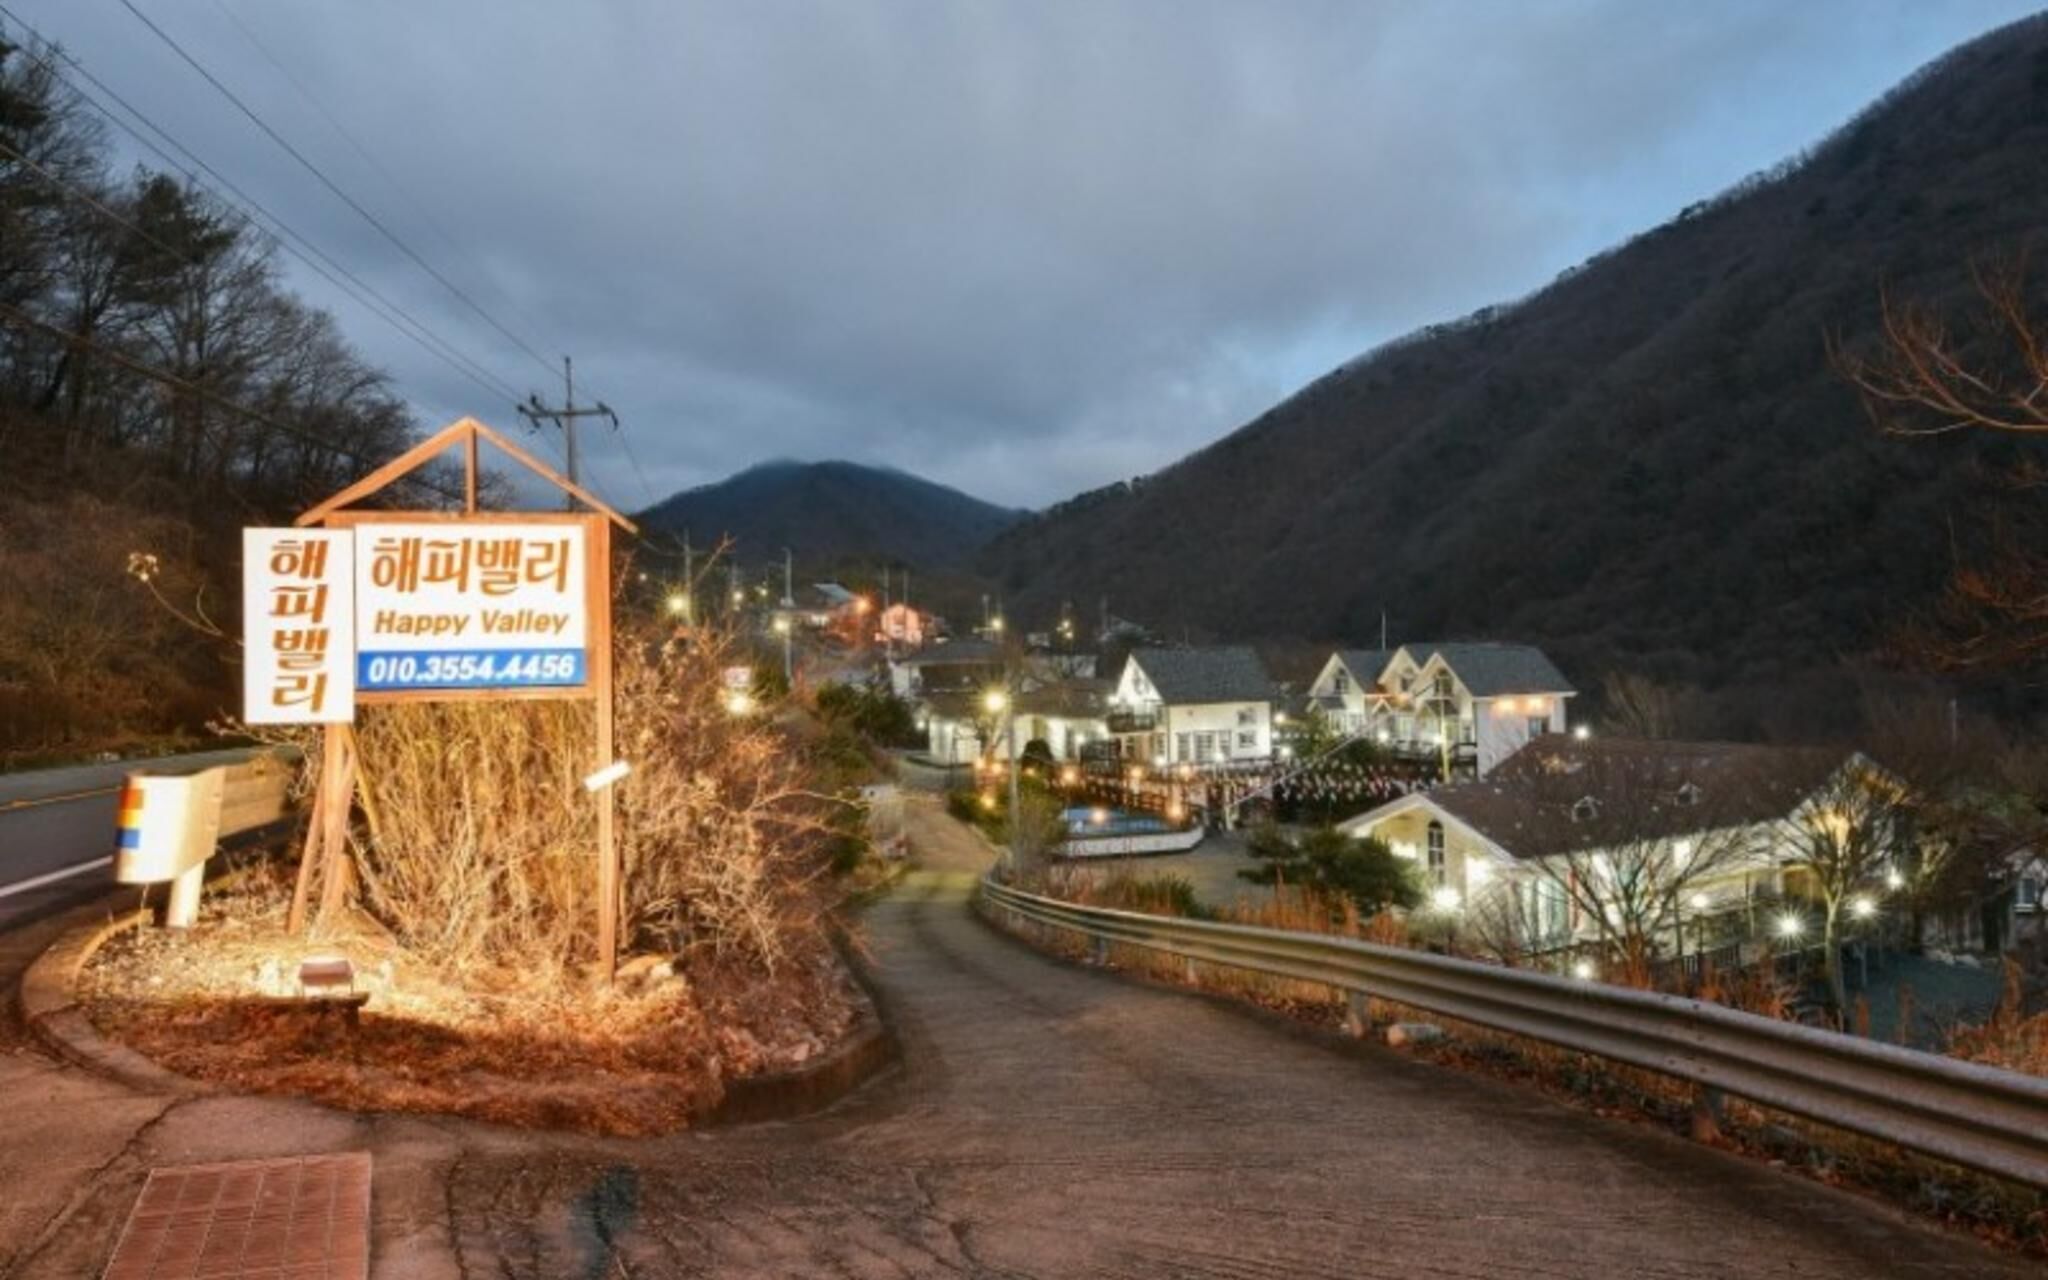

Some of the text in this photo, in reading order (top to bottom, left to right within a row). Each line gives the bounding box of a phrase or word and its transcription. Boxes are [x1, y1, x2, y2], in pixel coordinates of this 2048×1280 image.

[371, 537, 570, 596] 해피밸리
[269, 540, 328, 712] 해피밸리
[374, 608, 569, 636] Happy Valley
[368, 653, 575, 683] 010.3554.4456
